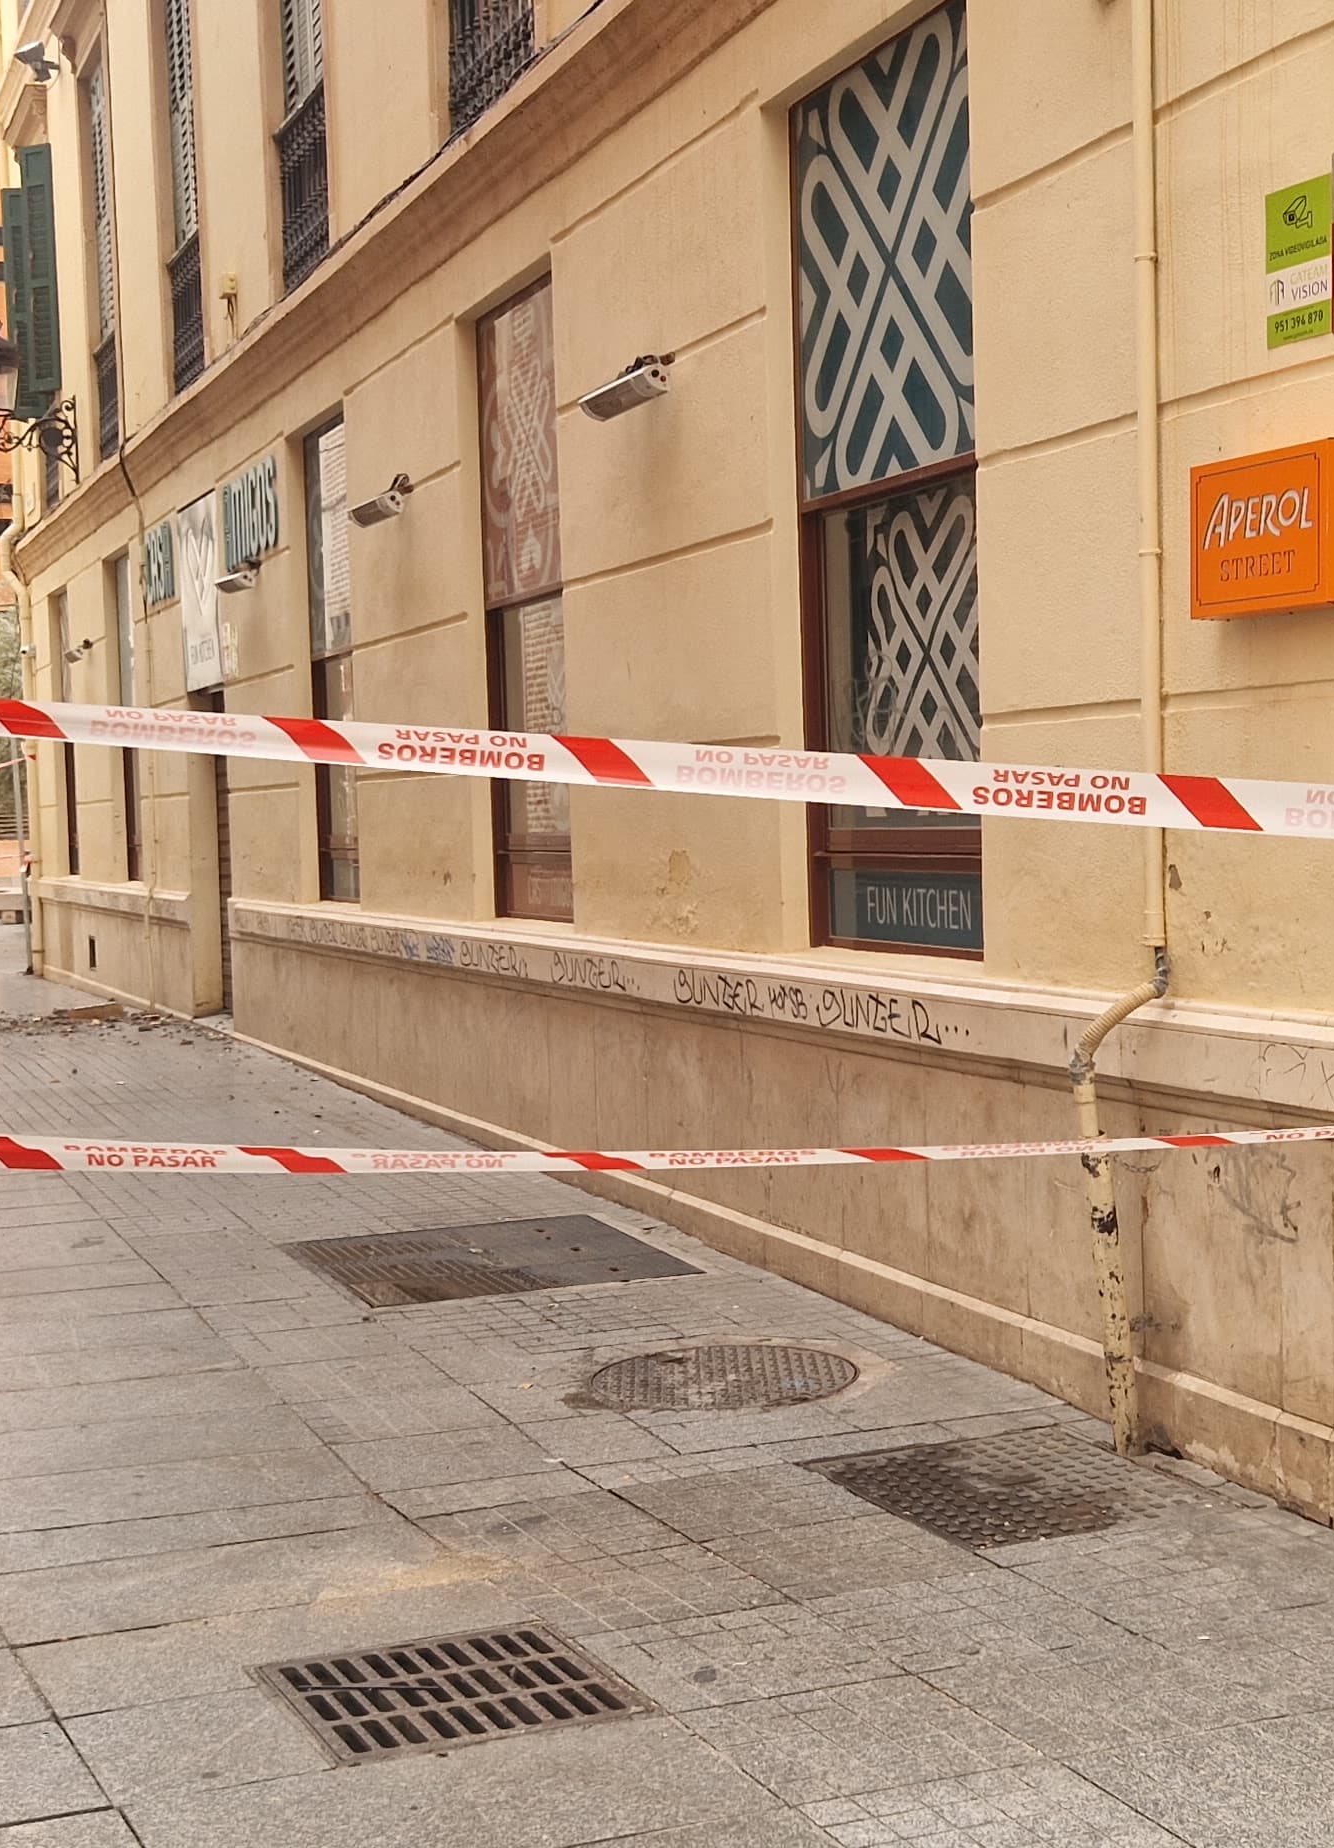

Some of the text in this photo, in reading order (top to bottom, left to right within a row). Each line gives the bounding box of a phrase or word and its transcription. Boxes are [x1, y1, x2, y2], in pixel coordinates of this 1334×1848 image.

[1291, 280, 1328, 301] VISION
[1275, 319, 1288, 333] 951
[1308, 310, 1323, 324] 870
[1203, 486, 1313, 550] APEROL
[1220, 549, 1296, 581] STREET
[396, 728, 527, 748] NO PASAR
[378, 742, 545, 772] BOMBEROS
[993, 768, 1131, 791] NO PASAR
[972, 786, 1147, 815] BOMBEROS
[867, 885, 972, 931] FUN KITCHEN
[1266, 1132, 1305, 1140] NO
[87, 1154, 217, 1168] NO PASAR
[668, 1156, 801, 1166] NO PASAR
